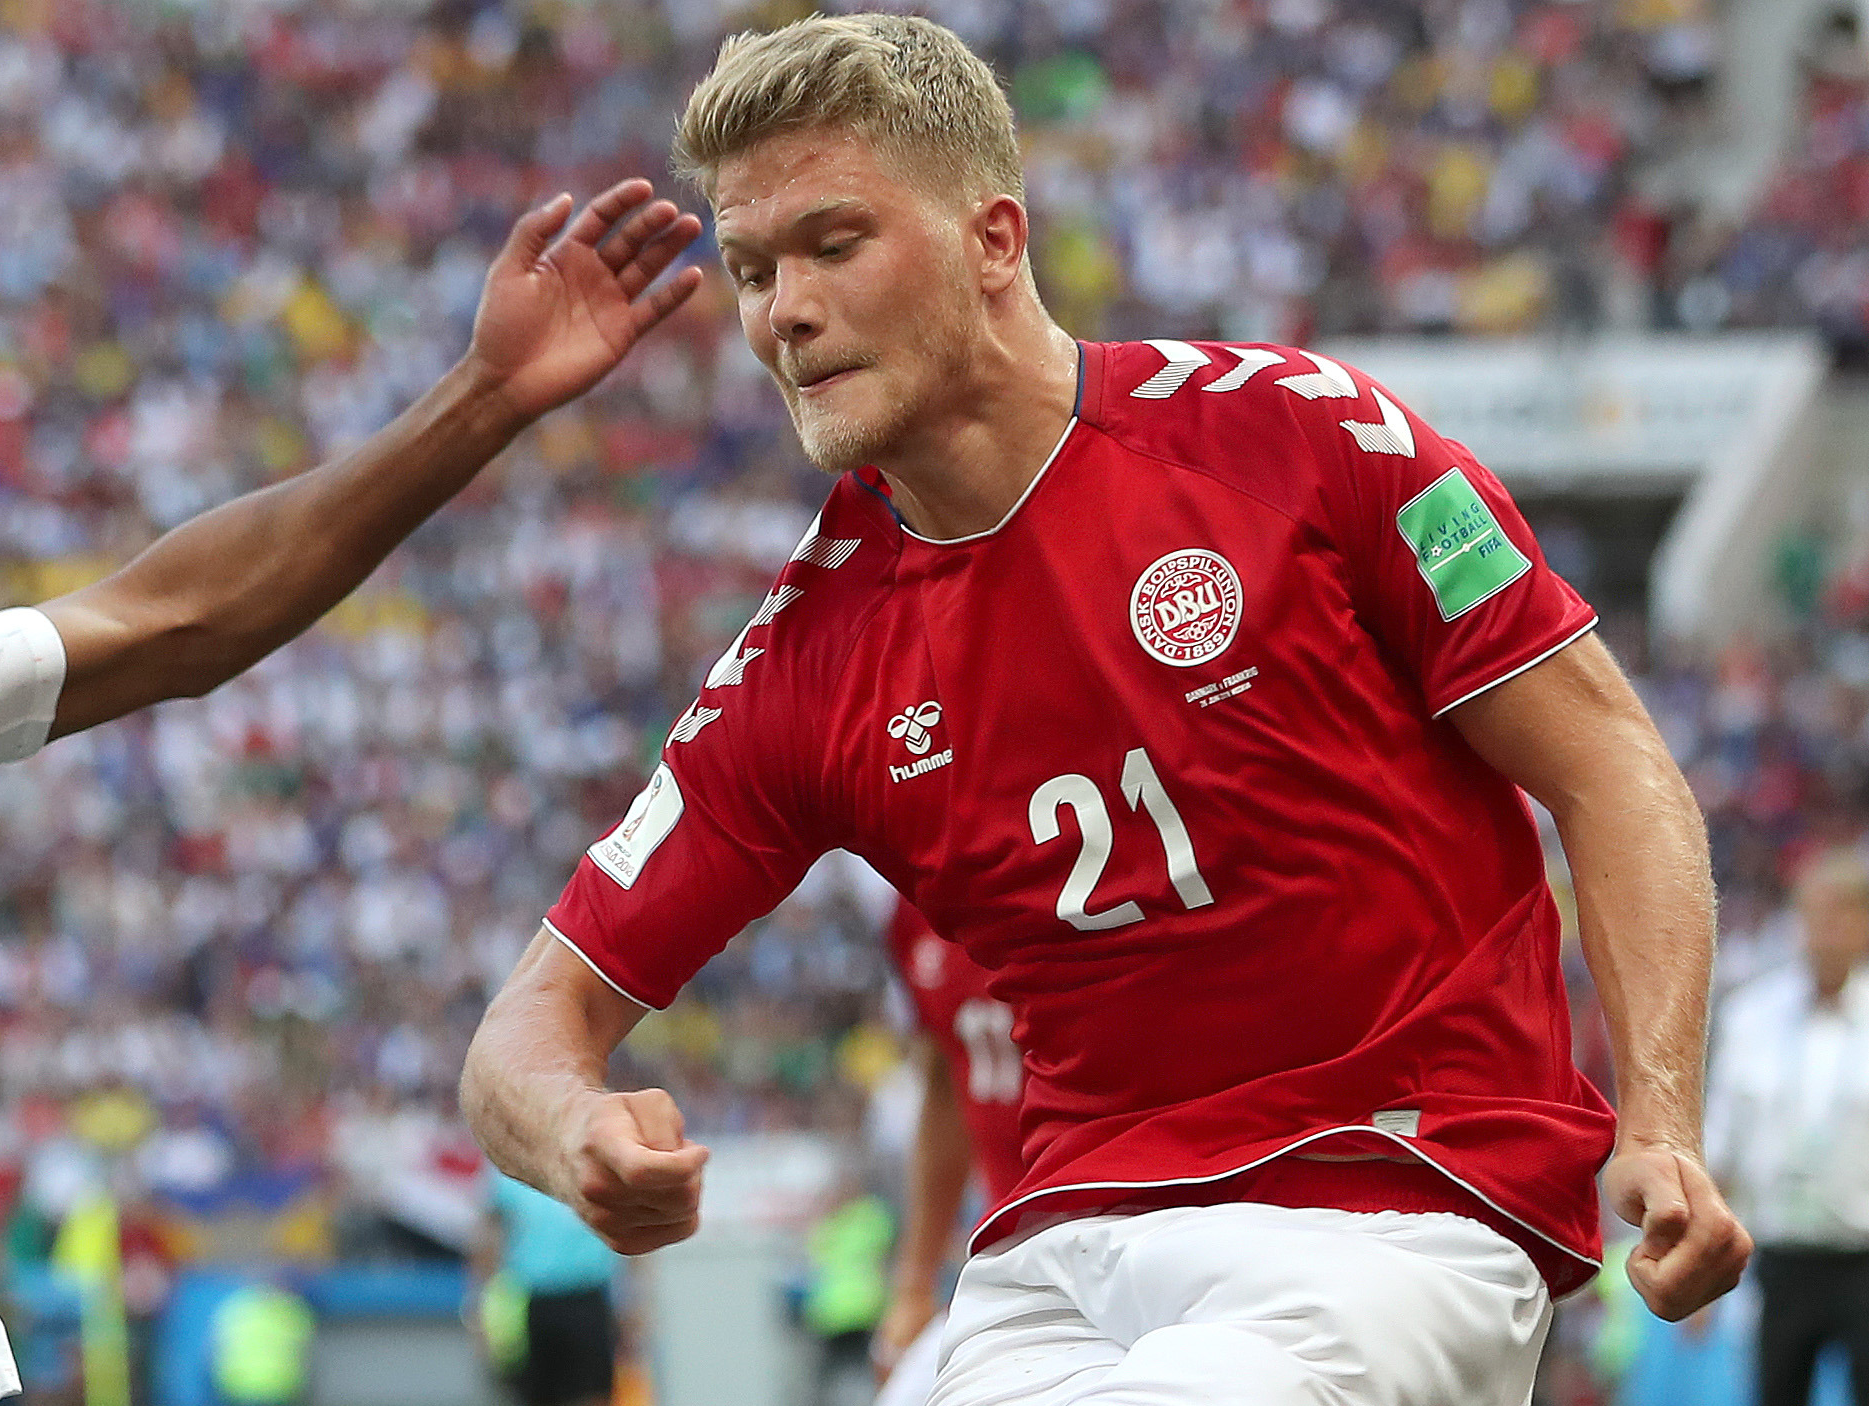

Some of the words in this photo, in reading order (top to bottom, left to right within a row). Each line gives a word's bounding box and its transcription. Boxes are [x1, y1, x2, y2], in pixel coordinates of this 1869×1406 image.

[1420, 502, 1480, 551] LIVING
[1478, 536, 1502, 559] FIFA
[1154, 580, 1222, 632] DBU
[1215, 568, 1236, 628] UNION
[1137, 602, 1177, 658] DANSK
[1183, 632, 1225, 660] 1889
[888, 748, 954, 784] humme
[1028, 747, 1215, 932] 21
